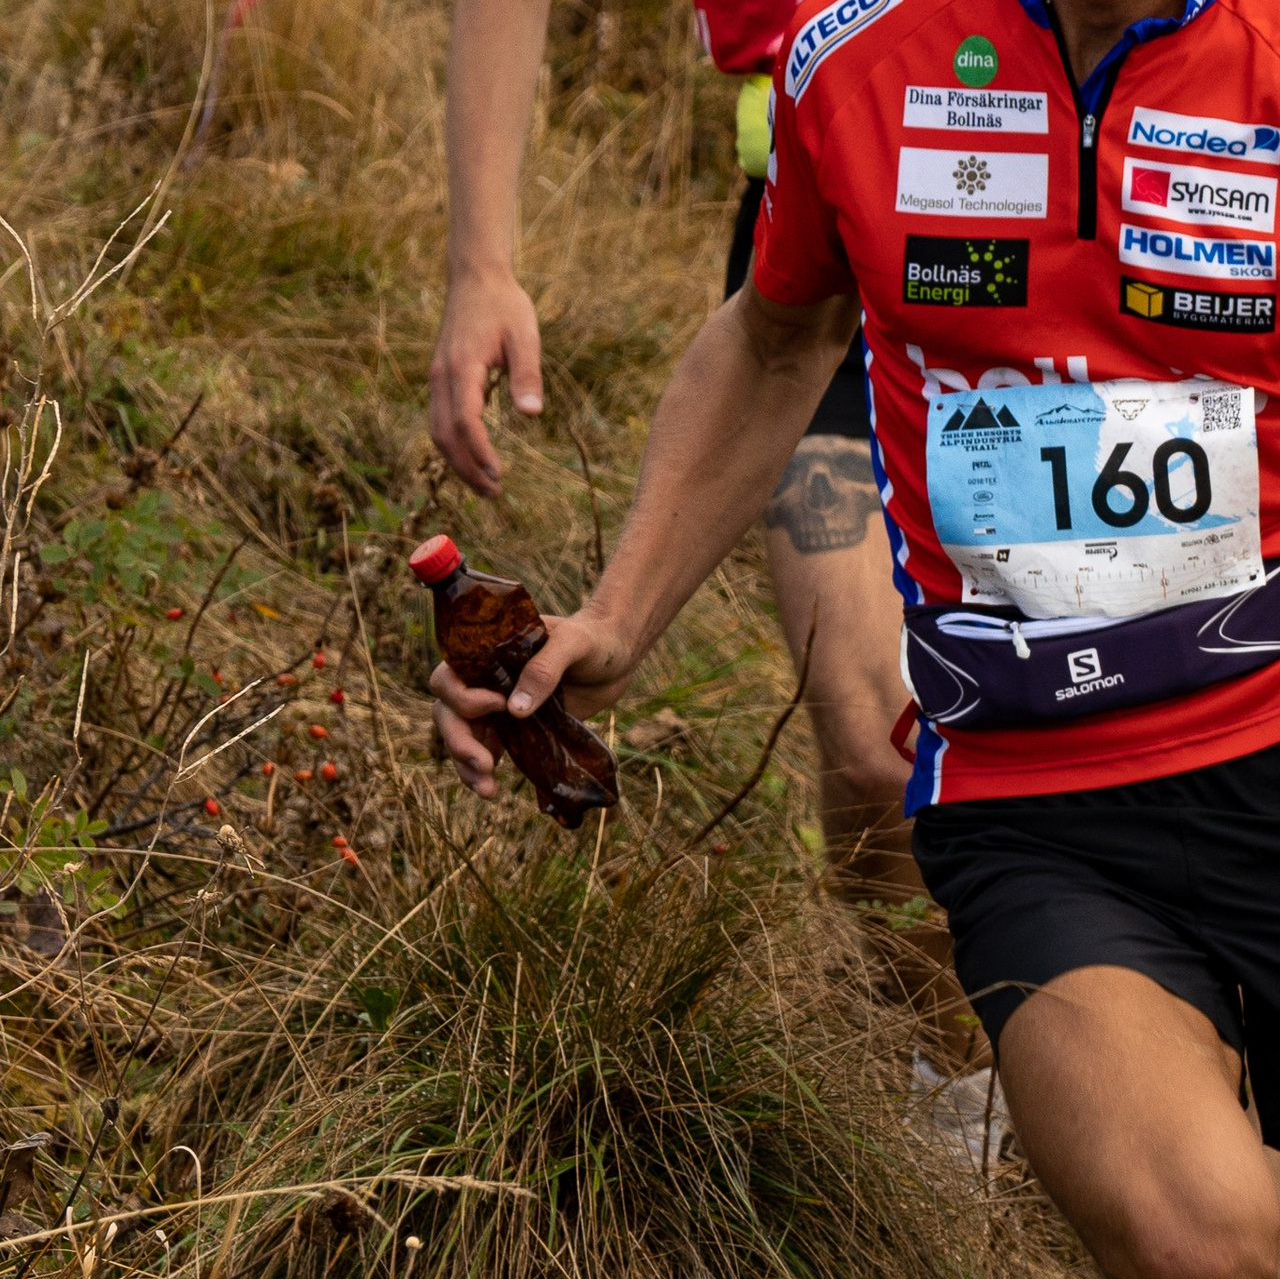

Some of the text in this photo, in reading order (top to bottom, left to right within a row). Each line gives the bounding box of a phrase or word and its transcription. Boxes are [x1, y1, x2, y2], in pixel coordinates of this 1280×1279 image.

[957, 51, 994, 68] dina
[908, 88, 1043, 113] Dina Försäkringar
[946, 110, 1003, 129] Bollnäs
[1131, 120, 1248, 157] Nordea
[899, 192, 1043, 215] Megasol Technologies
[1170, 180, 1271, 214] SYNSAM
[1187, 207, 1253, 222] www.synsam.com
[1124, 228, 1273, 267] HOLMEN
[907, 262, 981, 284] Bollnäs
[1229, 267, 1273, 278] SKOG
[907, 282, 970, 306] Energi
[1173, 291, 1273, 317] BEIJER
[1172, 310, 1271, 325] BYGGMATERIAL
[940, 429, 1022, 440] THREE RESORTS
[940, 435, 1023, 447] ALPINDUSTRIA
[963, 444, 998, 452] TRAIL
[1040, 438, 1213, 531] 160
[1055, 673, 1125, 701] salomon
